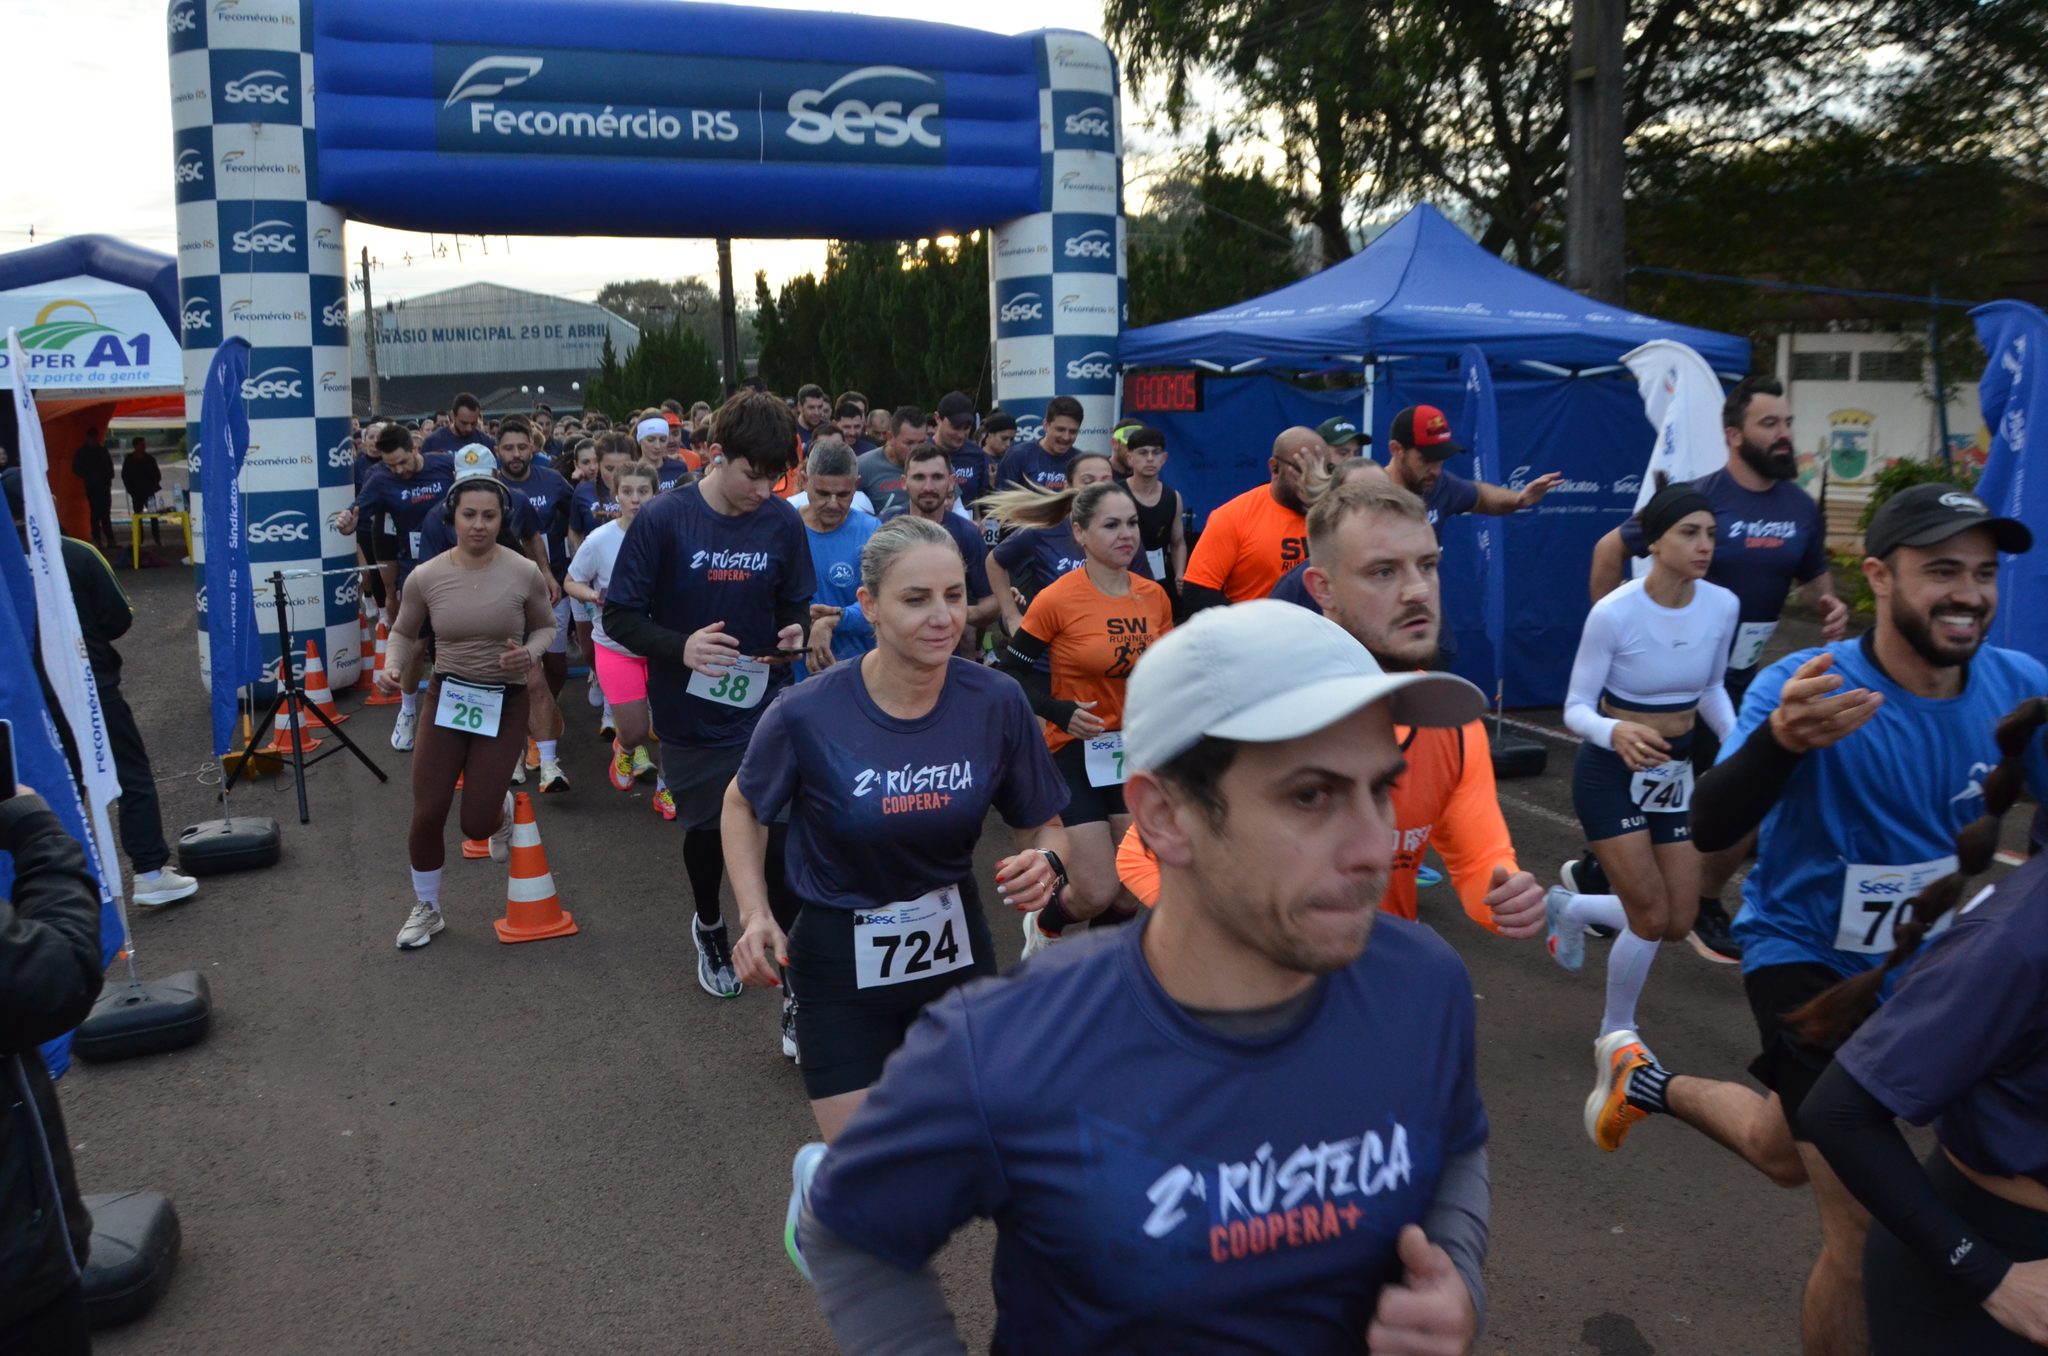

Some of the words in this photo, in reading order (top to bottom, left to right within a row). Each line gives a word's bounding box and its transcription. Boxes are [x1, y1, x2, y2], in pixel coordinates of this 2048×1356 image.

[218, 13, 279, 24] Fecomércio
[225, 81, 289, 104] Sesc
[471, 102, 681, 139] Fecomércio
[692, 111, 739, 141] RS
[786, 89, 941, 147] Sesc
[1065, 114, 1109, 138] Sesc
[225, 163, 284, 174] Fecomércio
[233, 231, 296, 253] Sesc
[1064, 237, 1110, 258] Sesc
[233, 311, 291, 321] Fecomércio
[1001, 302, 1042, 322] Sesc
[432, 326, 515, 343] MUNICIPAL
[521, 326, 540, 340] 29
[545, 325, 563, 339] DE
[84, 333, 150, 367] A1
[44, 372, 83, 384] parte
[88, 371, 105, 381] da
[111, 371, 150, 384] gente
[1066, 360, 1112, 379] Sesc
[241, 378, 302, 399] Sesc
[1015, 427, 1045, 441] esc
[301, 456, 313, 464] RS
[228, 478, 238, 549] Sindicatos
[248, 523, 309, 544] Sesc
[711, 549, 769, 571] RÚSTICA
[708, 568, 752, 581] COOPERA+
[307, 596, 320, 605] RS
[1107, 617, 1147, 634] SW
[1110, 634, 1154, 643] RUNNERS
[709, 672, 750, 702] 38
[452, 703, 483, 729] 26
[886, 760, 974, 796] RÚSTICA
[882, 792, 953, 815] COOPERA+
[1641, 778, 1684, 808] 740
[1859, 880, 1904, 894] Sesc
[866, 913, 896, 925] Sesc
[872, 919, 959, 978] 724
[1218, 1122, 1414, 1222] RÚSTICA
[1209, 1200, 1368, 1263] COOPERA+
